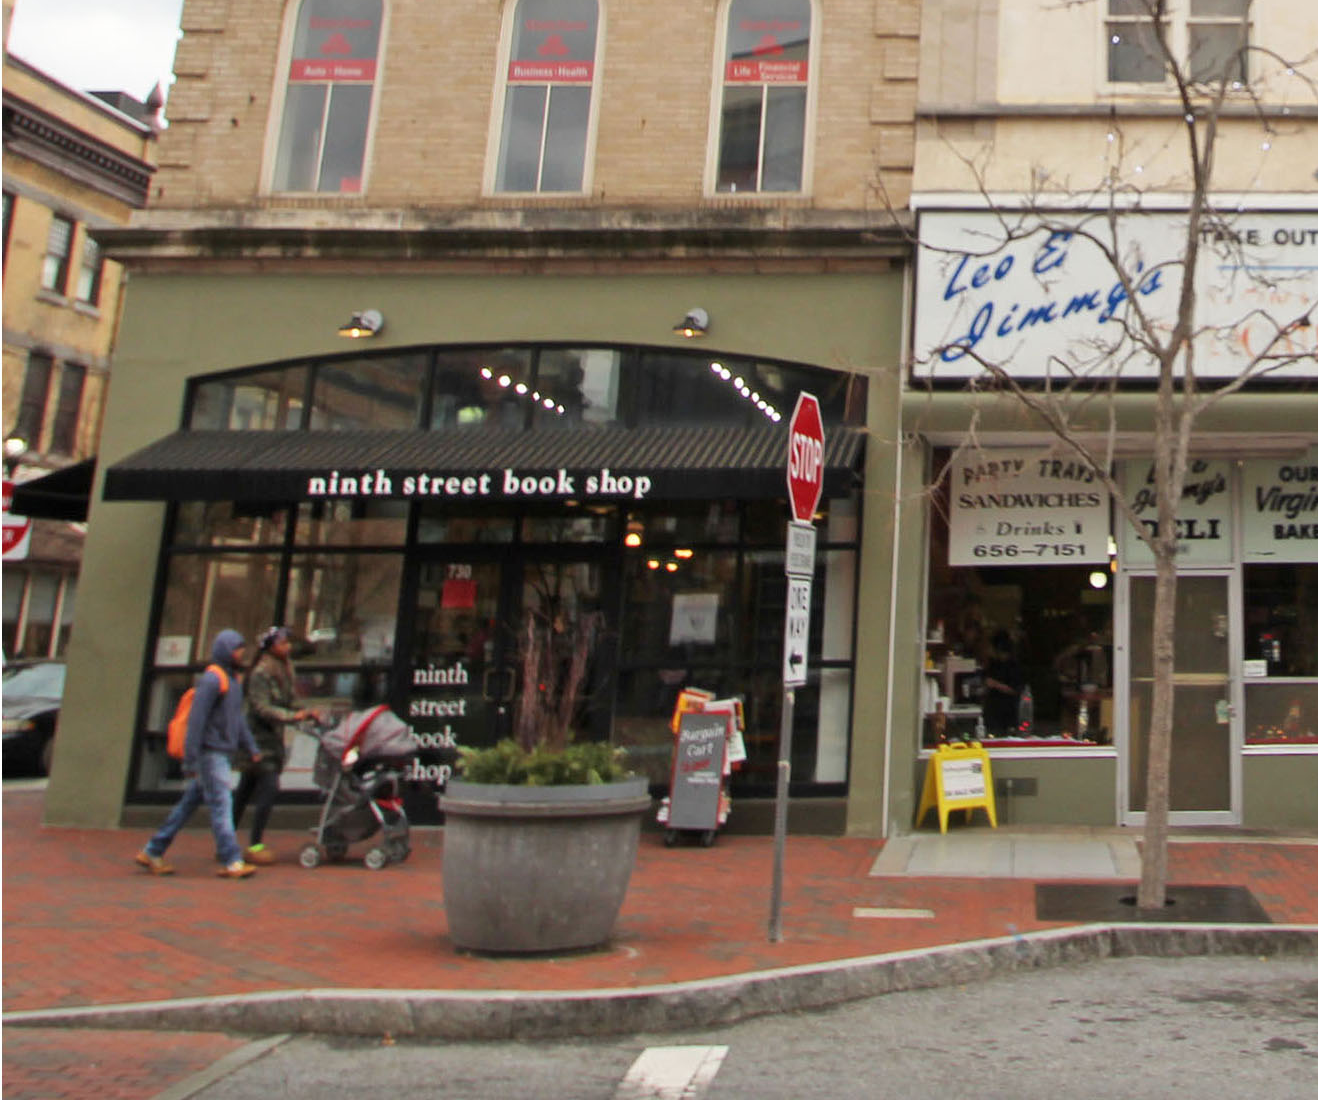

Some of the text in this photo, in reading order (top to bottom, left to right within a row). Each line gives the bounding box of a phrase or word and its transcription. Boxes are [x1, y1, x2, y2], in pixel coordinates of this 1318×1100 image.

[514, 66, 588, 77] Business Health
[733, 66, 751, 77] Life
[1199, 229, 1260, 246] TAKE
[943, 230, 1074, 302] Leo &
[940, 261, 1163, 363] Jimmy's
[791, 431, 822, 484] STOP
[308, 468, 652, 499] ninth street book shop
[963, 459, 1096, 487] PARTY TRAYS
[959, 492, 1101, 510] SANDWICHES
[996, 520, 1065, 537] Drinks
[973, 543, 1087, 558] 656-7151
[413, 662, 469, 686] ninth
[409, 699, 467, 717] street
[408, 725, 458, 749] book
[405, 758, 453, 785] shop
